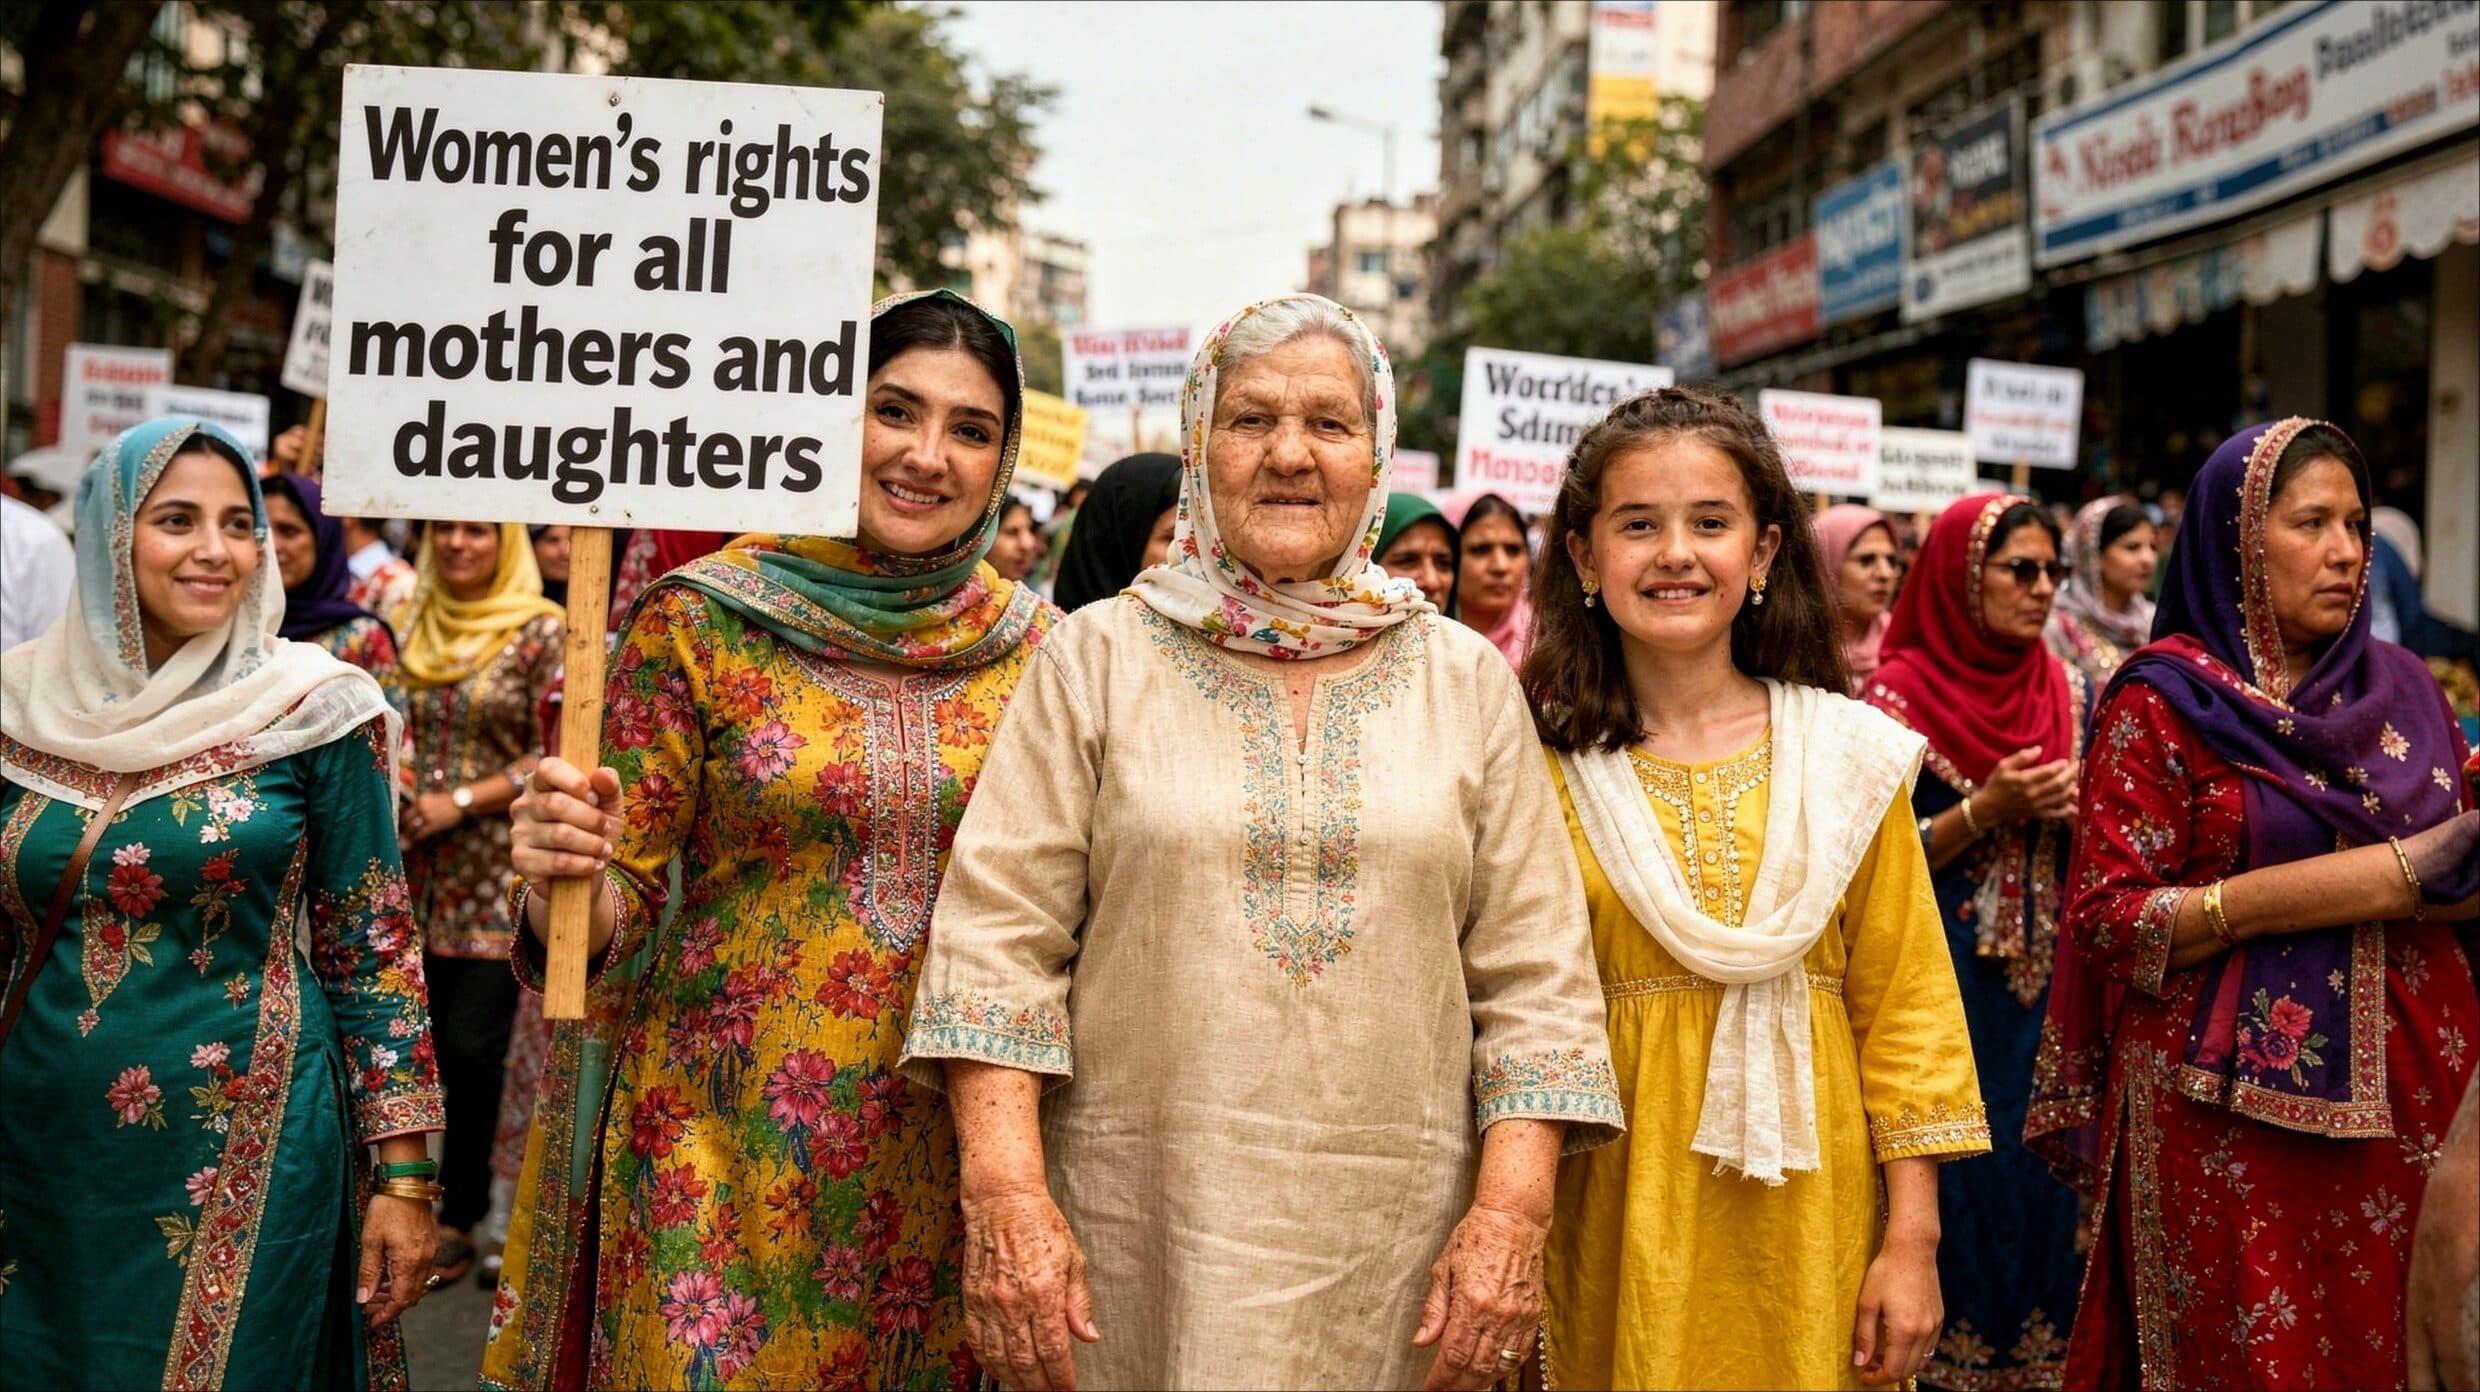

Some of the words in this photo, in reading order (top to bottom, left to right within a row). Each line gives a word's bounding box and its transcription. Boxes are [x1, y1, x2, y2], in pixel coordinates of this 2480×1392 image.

[365, 106, 661, 191] Women’s
[686, 119, 870, 218] rights
[490, 209, 612, 286] for
[635, 218, 731, 293] all
[350, 306, 690, 388] mothers
[714, 321, 856, 395] and
[394, 401, 822, 504] daughters
